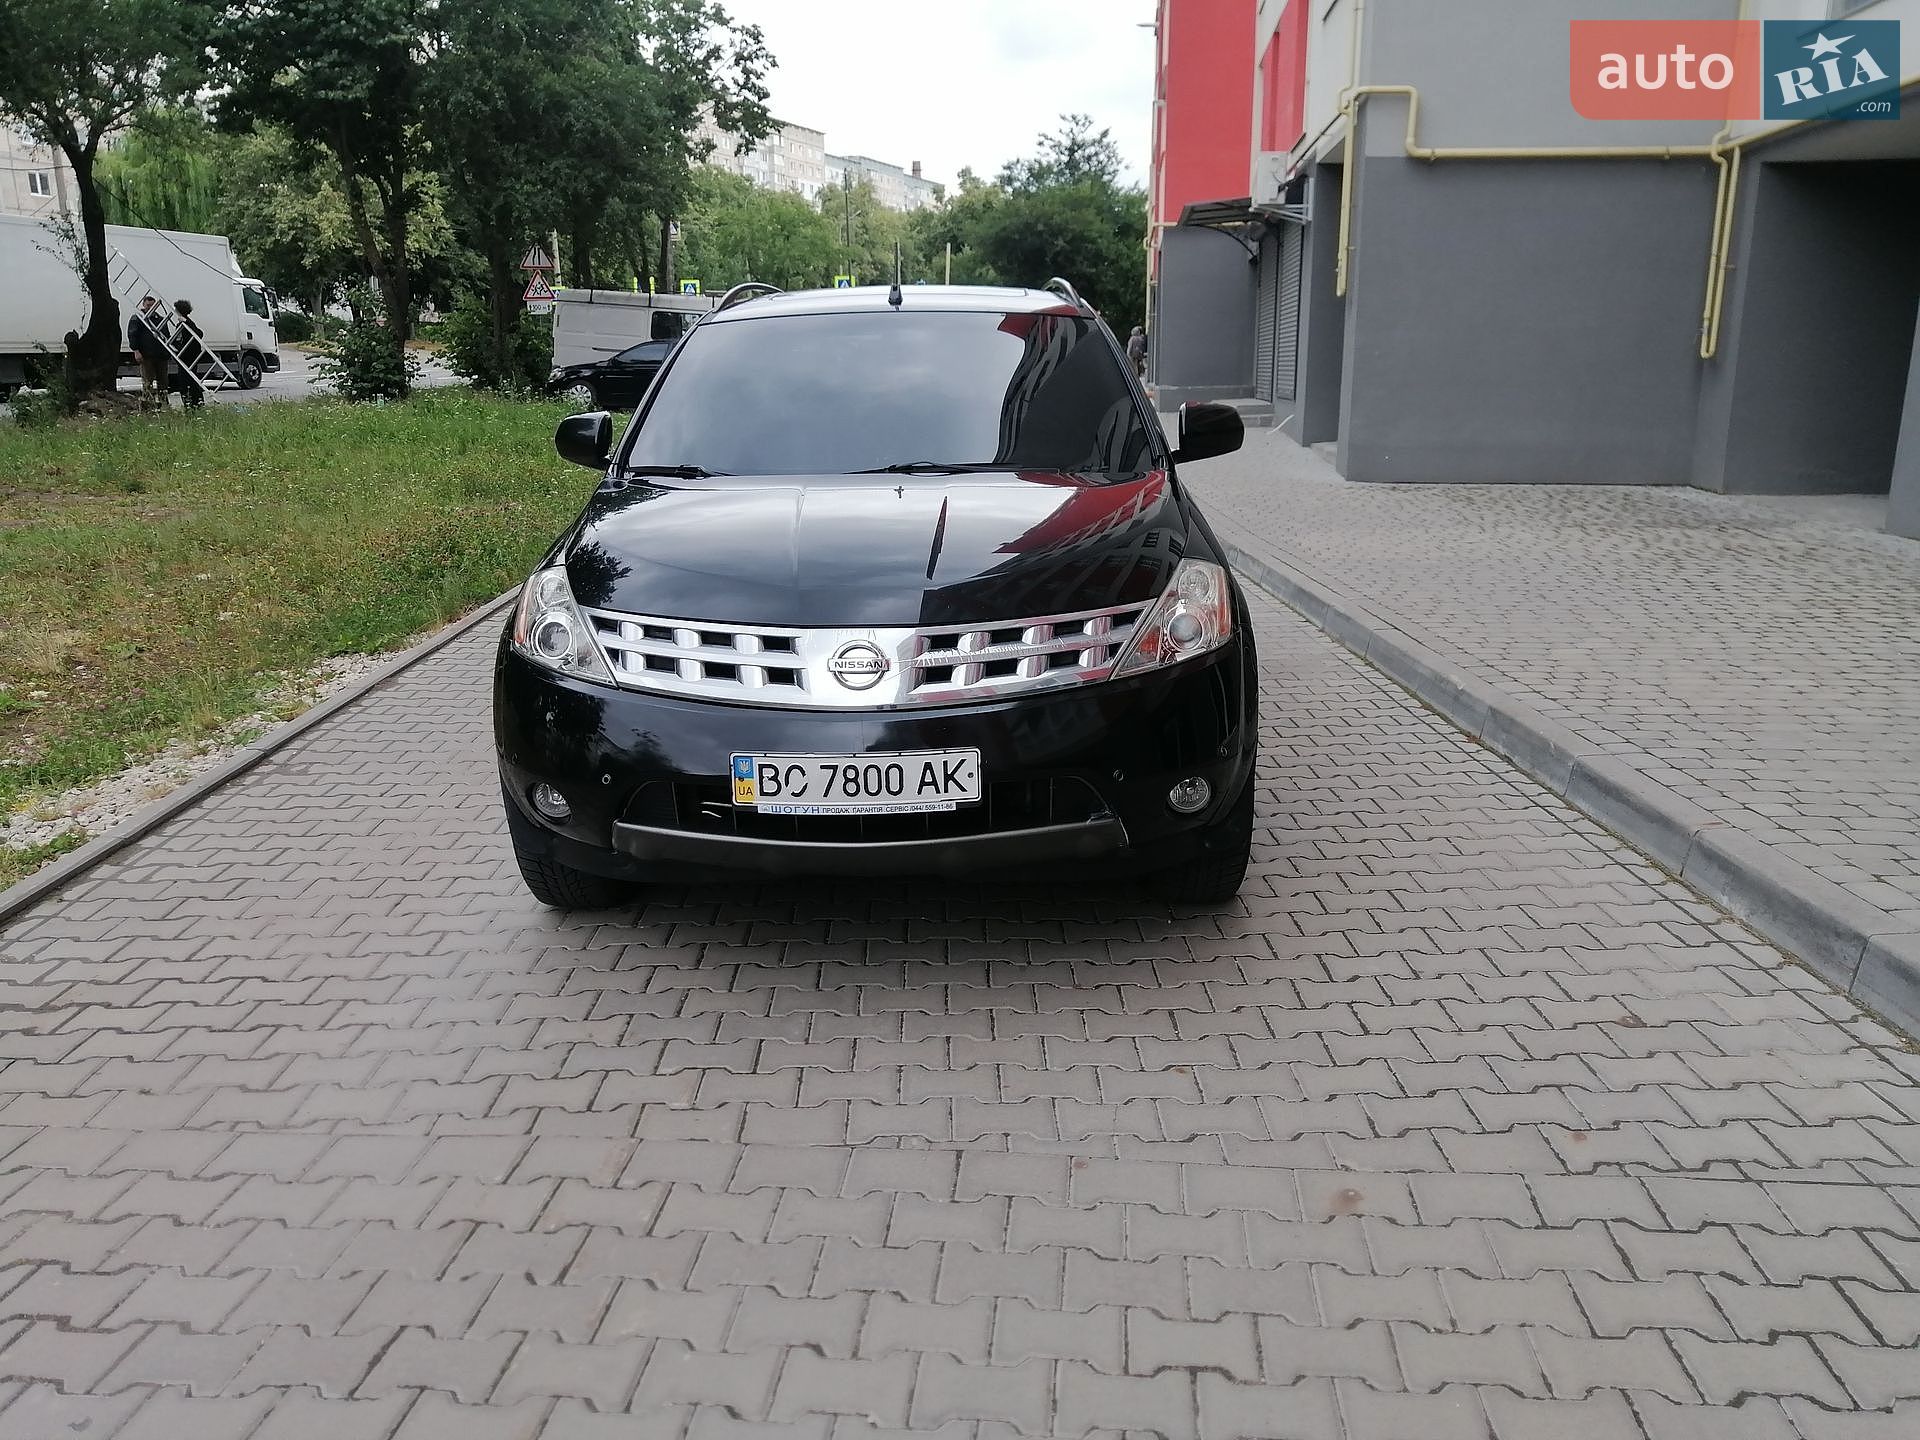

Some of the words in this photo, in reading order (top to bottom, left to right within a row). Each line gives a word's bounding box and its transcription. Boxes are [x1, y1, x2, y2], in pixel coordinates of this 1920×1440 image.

[834, 661, 883, 669] NISSAN
[819, 762, 905, 798] 7800
[916, 758, 969, 796] AK
[738, 785, 753, 796] UA
[771, 805, 820, 814] ШОГУН
